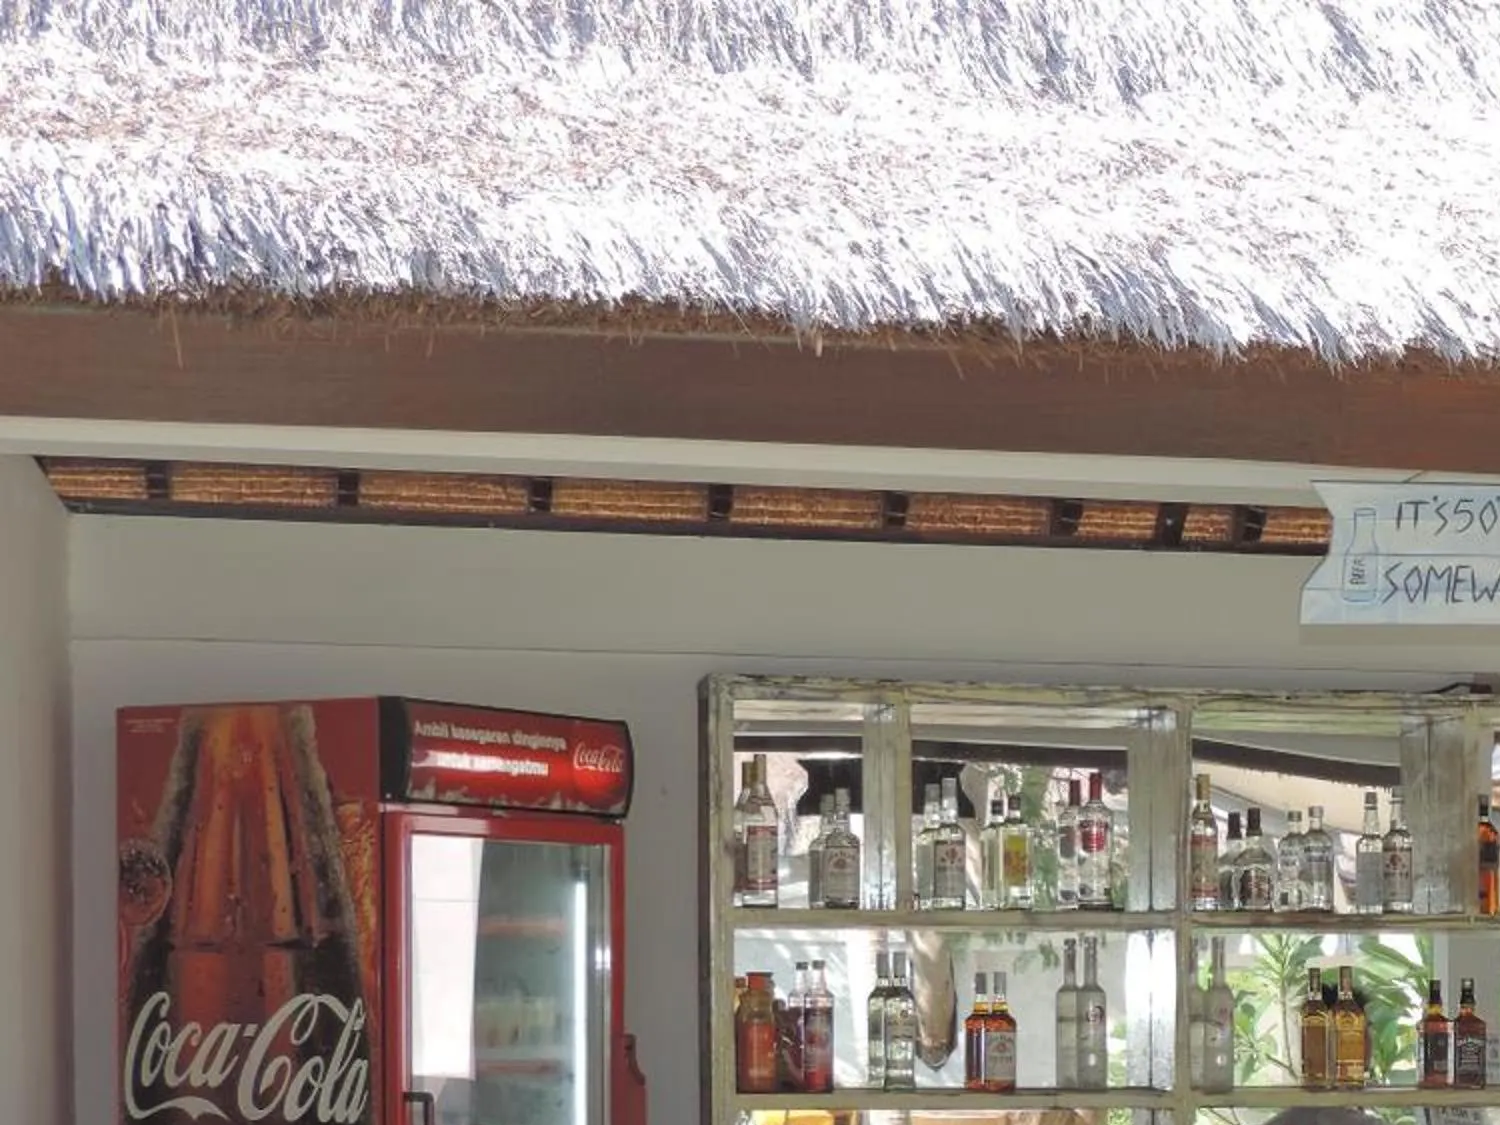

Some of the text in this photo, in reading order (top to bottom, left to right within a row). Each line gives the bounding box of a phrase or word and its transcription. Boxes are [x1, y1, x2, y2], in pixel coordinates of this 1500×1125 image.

[414, 720, 449, 738] Ambil
[573, 742, 624, 773] Coca-Cola
[124, 992, 370, 1125] Coca-Cola
